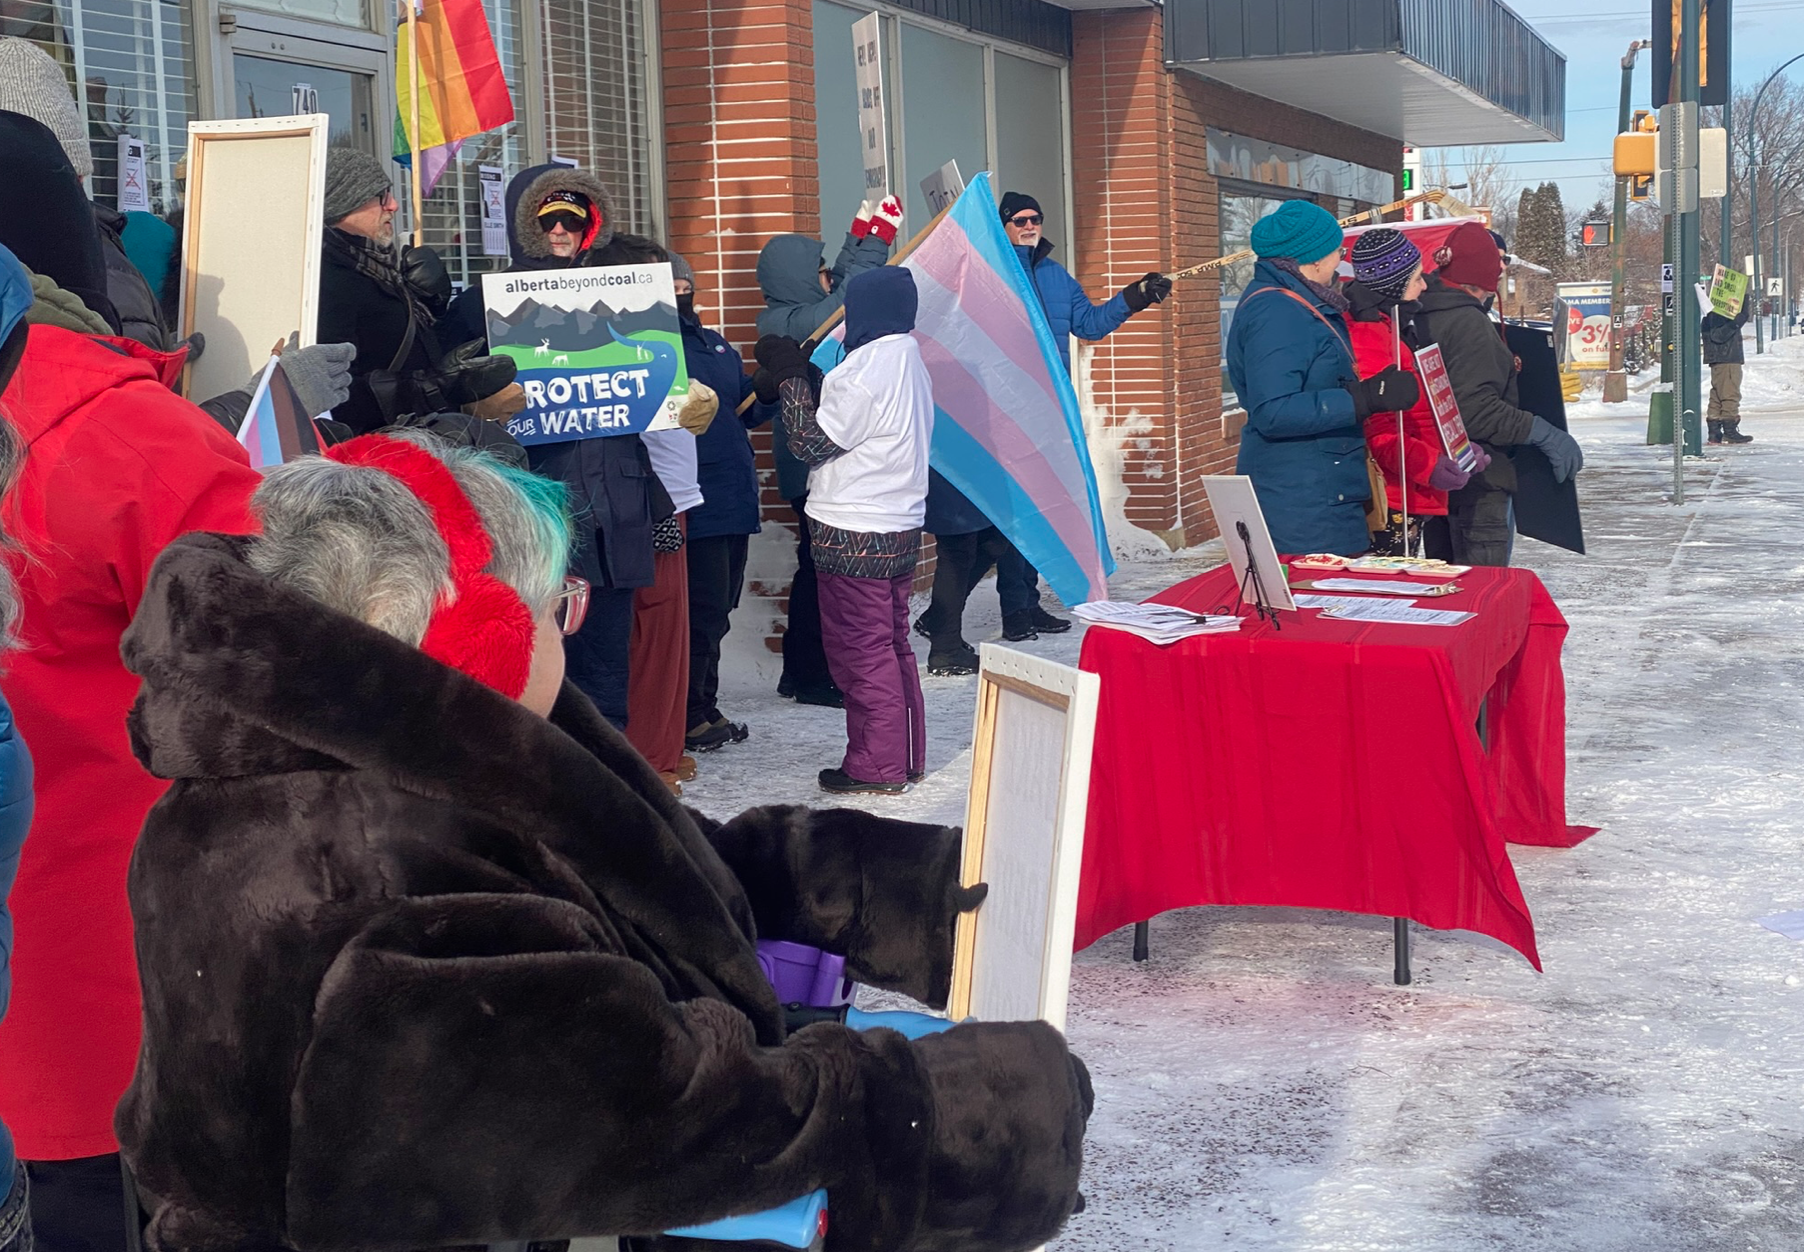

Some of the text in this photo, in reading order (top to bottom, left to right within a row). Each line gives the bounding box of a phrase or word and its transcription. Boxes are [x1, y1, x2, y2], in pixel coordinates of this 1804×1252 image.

[293, 87, 317, 115] 740
[505, 271, 653, 293] albertabeyondcoal.ca
[524, 368, 649, 409] ROTECT
[507, 404, 630, 436] OUR WATER
